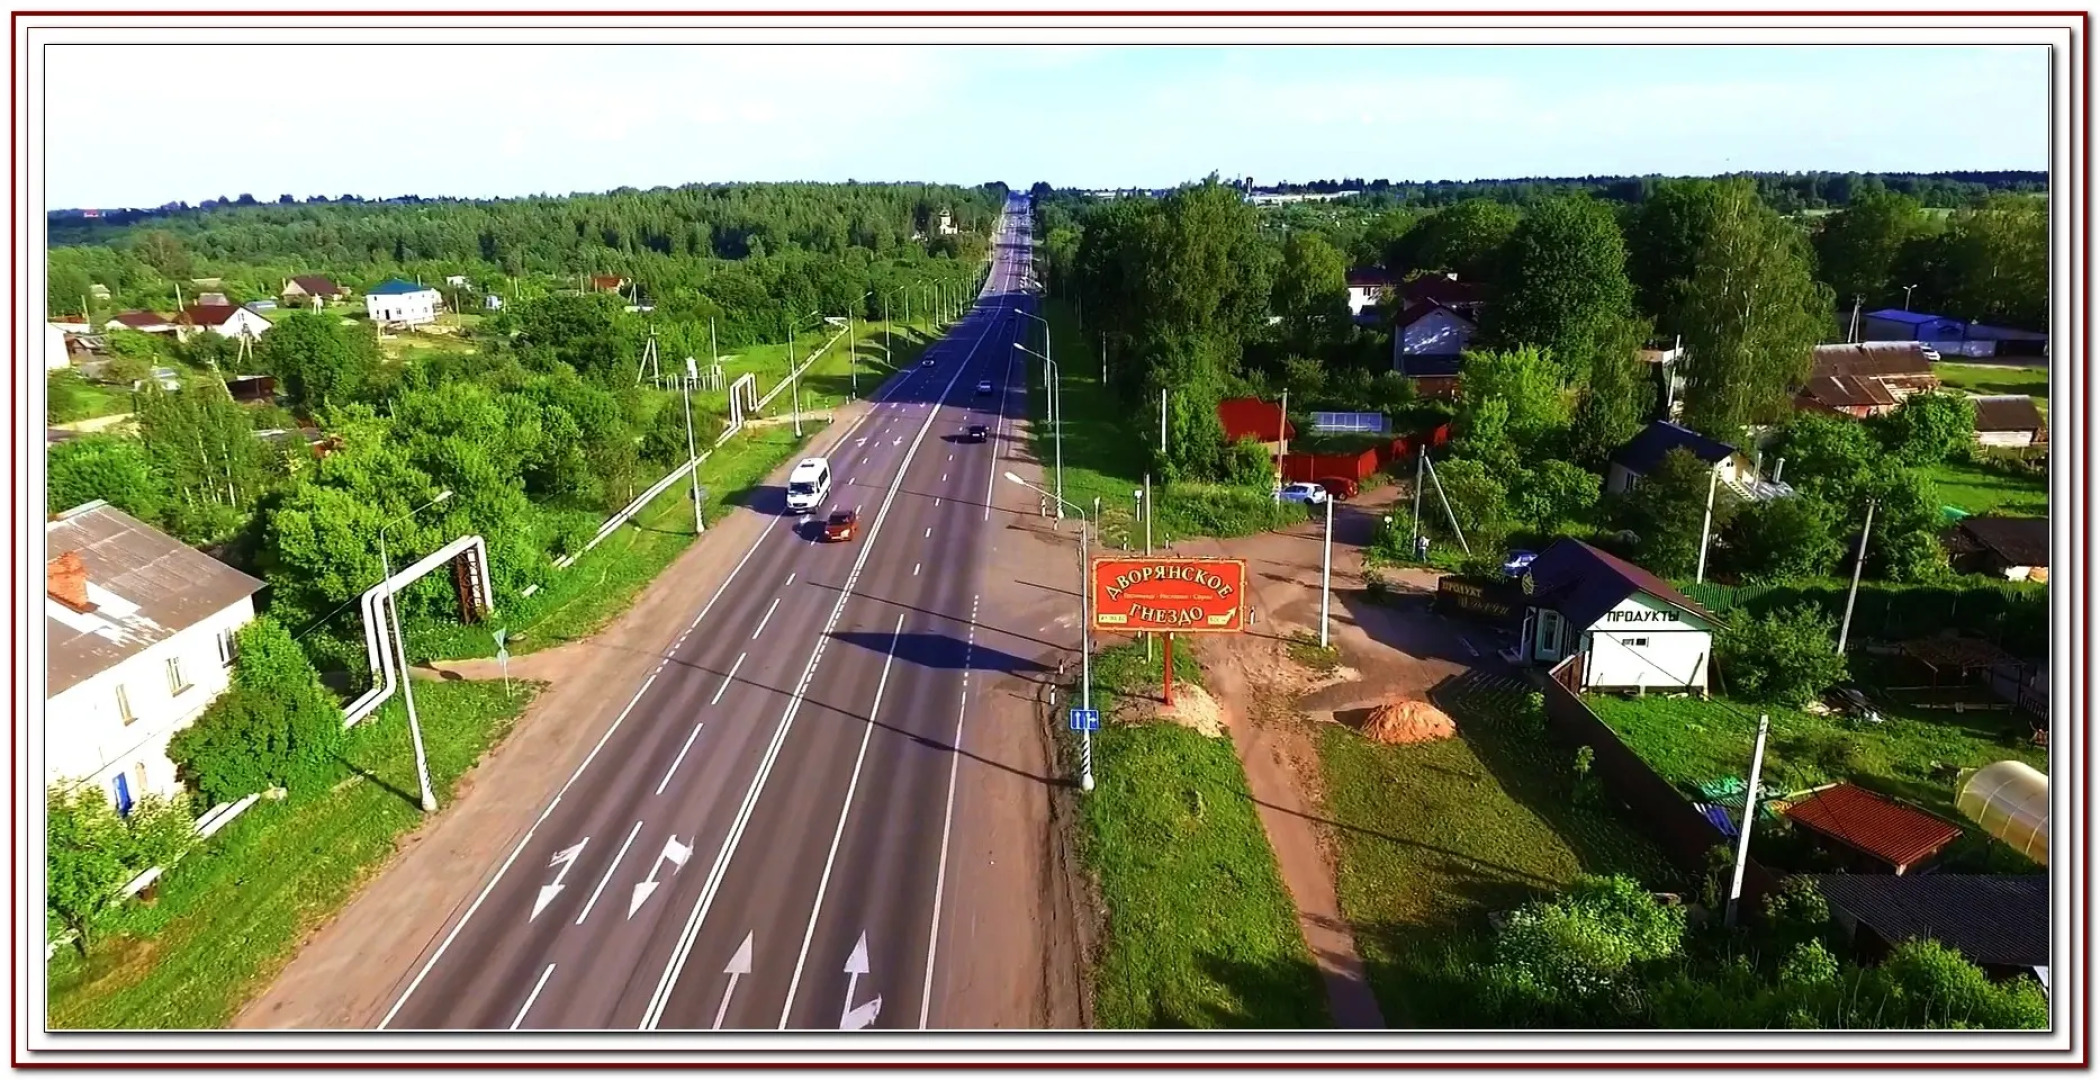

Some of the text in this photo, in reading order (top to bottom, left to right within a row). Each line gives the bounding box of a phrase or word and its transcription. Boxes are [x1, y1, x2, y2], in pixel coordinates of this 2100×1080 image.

[1105, 565, 1234, 601] ДВОРЯНСКОЕ
[1129, 603, 1204, 626] ГНЕЗДО
[1607, 610, 1680, 622] ПРОДУКТЫ
